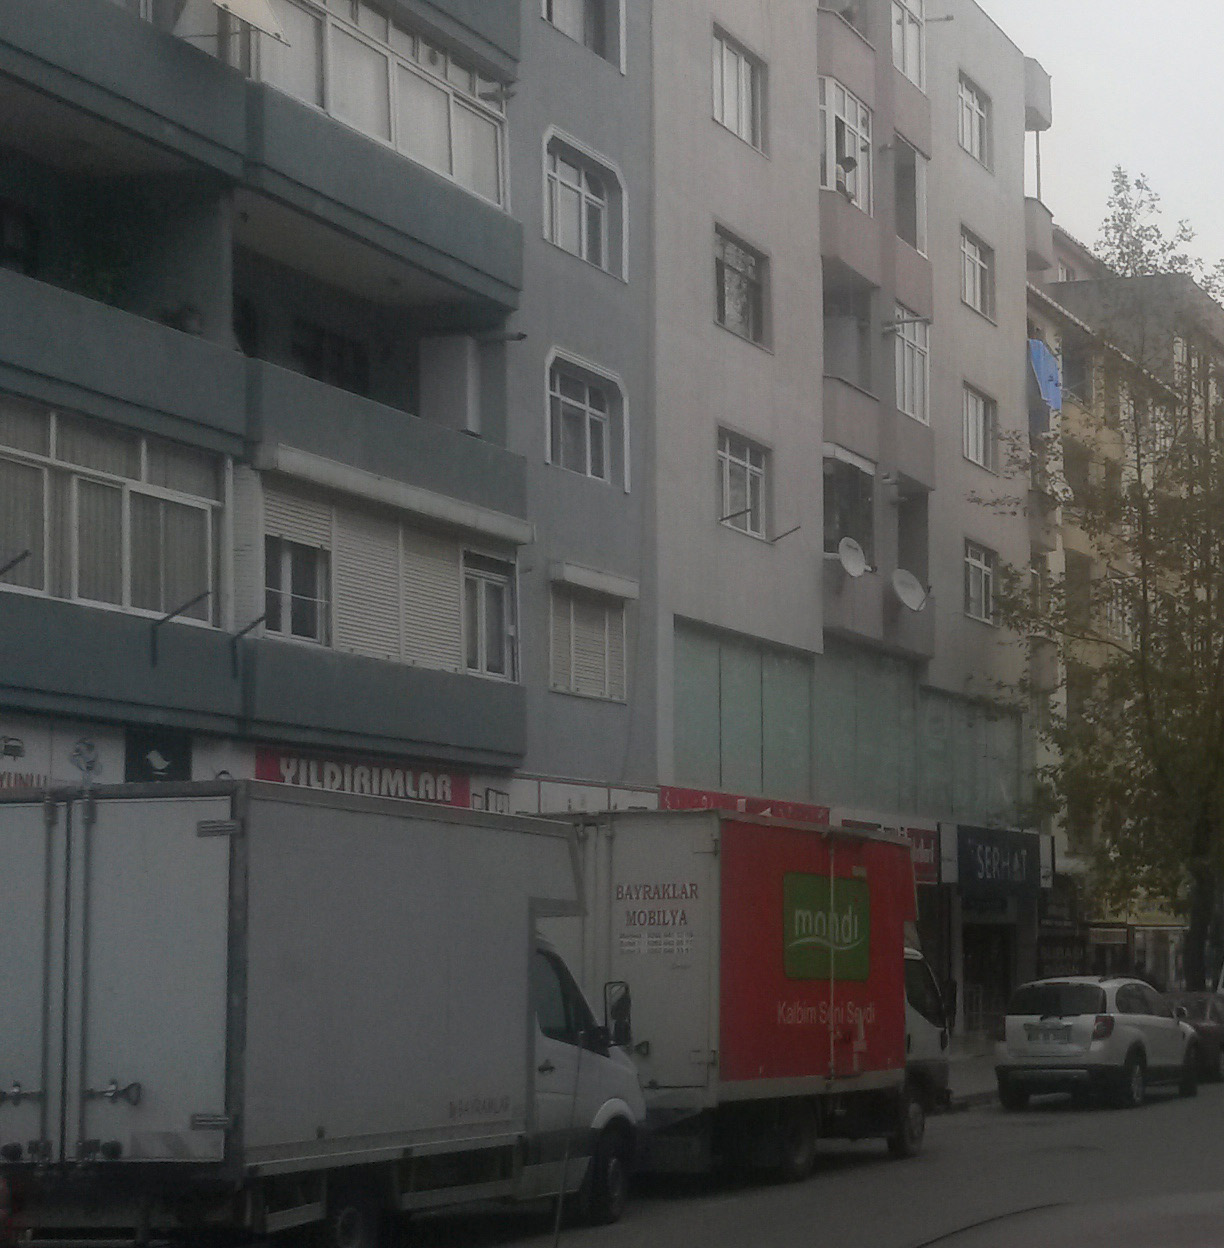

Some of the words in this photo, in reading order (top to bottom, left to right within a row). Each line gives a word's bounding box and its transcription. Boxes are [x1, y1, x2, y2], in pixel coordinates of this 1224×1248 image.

[280, 757, 452, 801] YILDIRIMLAR
[616, 883, 699, 900] BAYRAKLAR
[625, 909, 688, 927] MOBILYA
